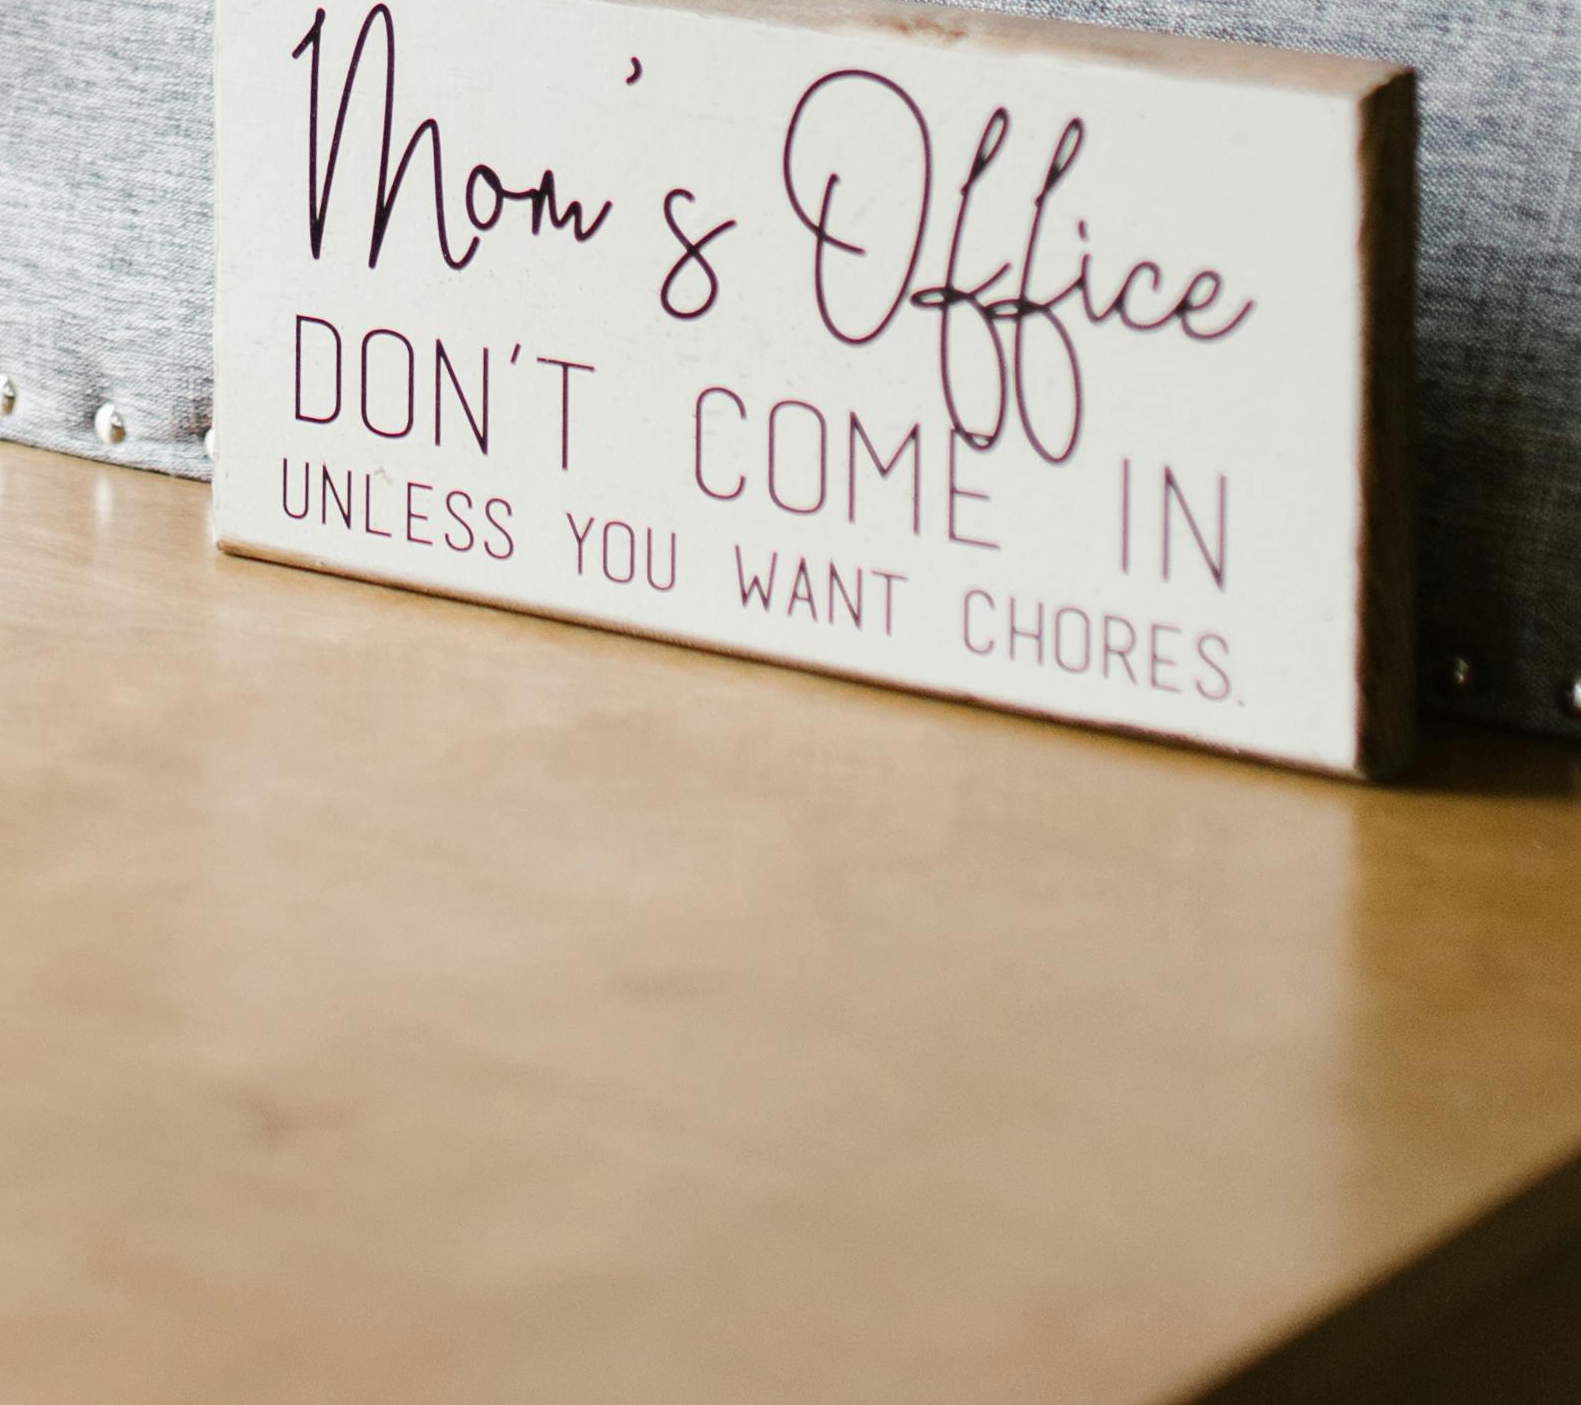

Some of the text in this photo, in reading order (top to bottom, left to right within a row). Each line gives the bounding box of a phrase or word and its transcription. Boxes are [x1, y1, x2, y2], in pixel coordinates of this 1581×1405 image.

[291, 2, 1257, 464] Mom's Office
[280, 455, 1247, 709] UNLESS YOU WANT CHORES.
[293, 311, 1230, 592] DON'T COME IN
